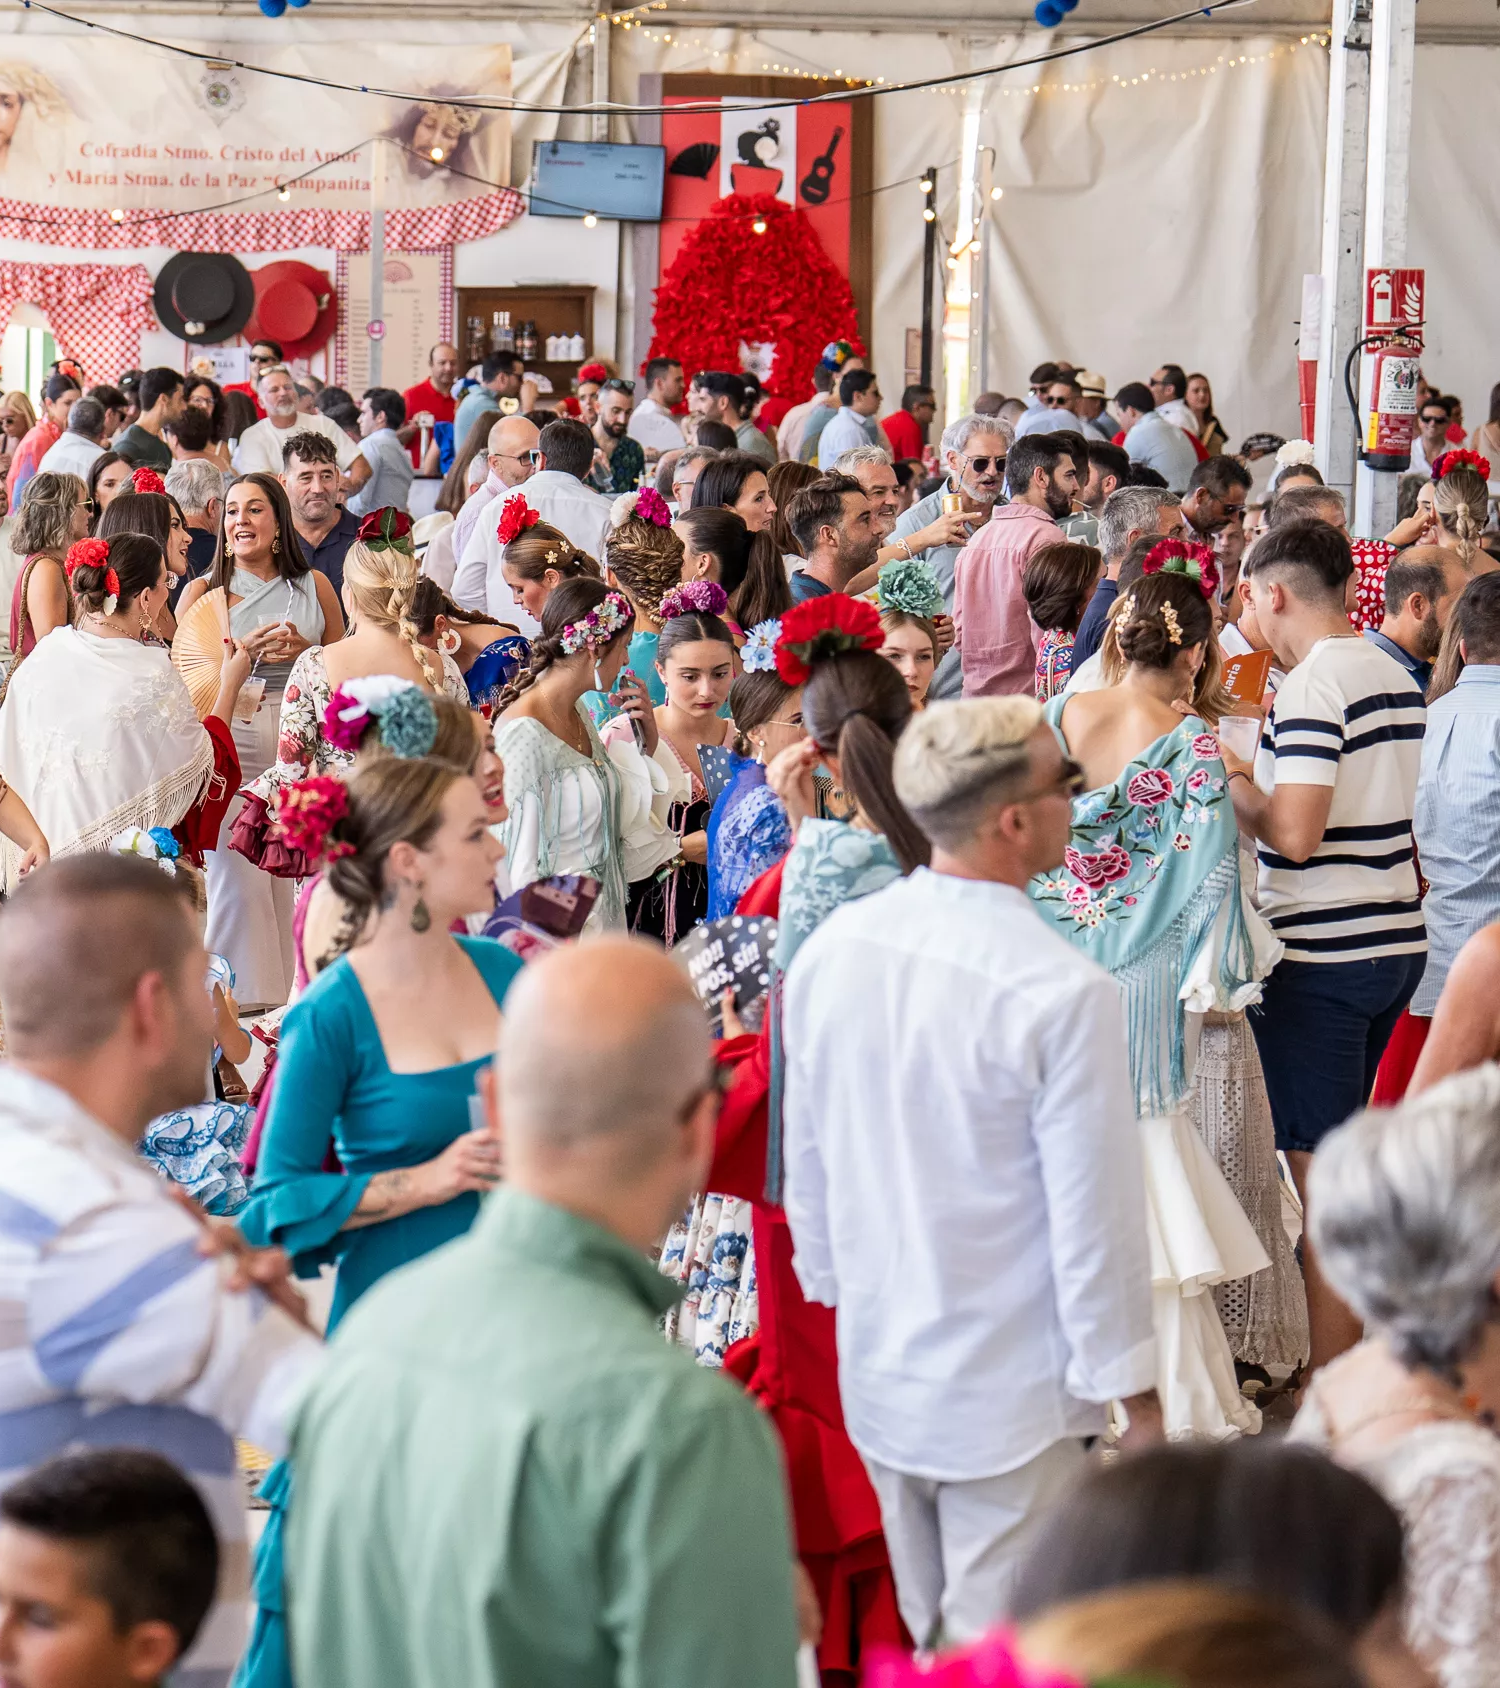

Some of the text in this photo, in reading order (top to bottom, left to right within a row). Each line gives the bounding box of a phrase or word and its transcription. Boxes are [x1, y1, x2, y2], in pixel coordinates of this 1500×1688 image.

[164, 144, 213, 160] Stmo.
[220, 144, 274, 161] Cristo
[279, 147, 305, 162] del
[310, 148, 361, 163] Amor
[48, 172, 59, 188] y
[123, 170, 173, 186] Stma.
[179, 172, 200, 187] de
[205, 172, 220, 187] la
[227, 173, 257, 188] Paz
